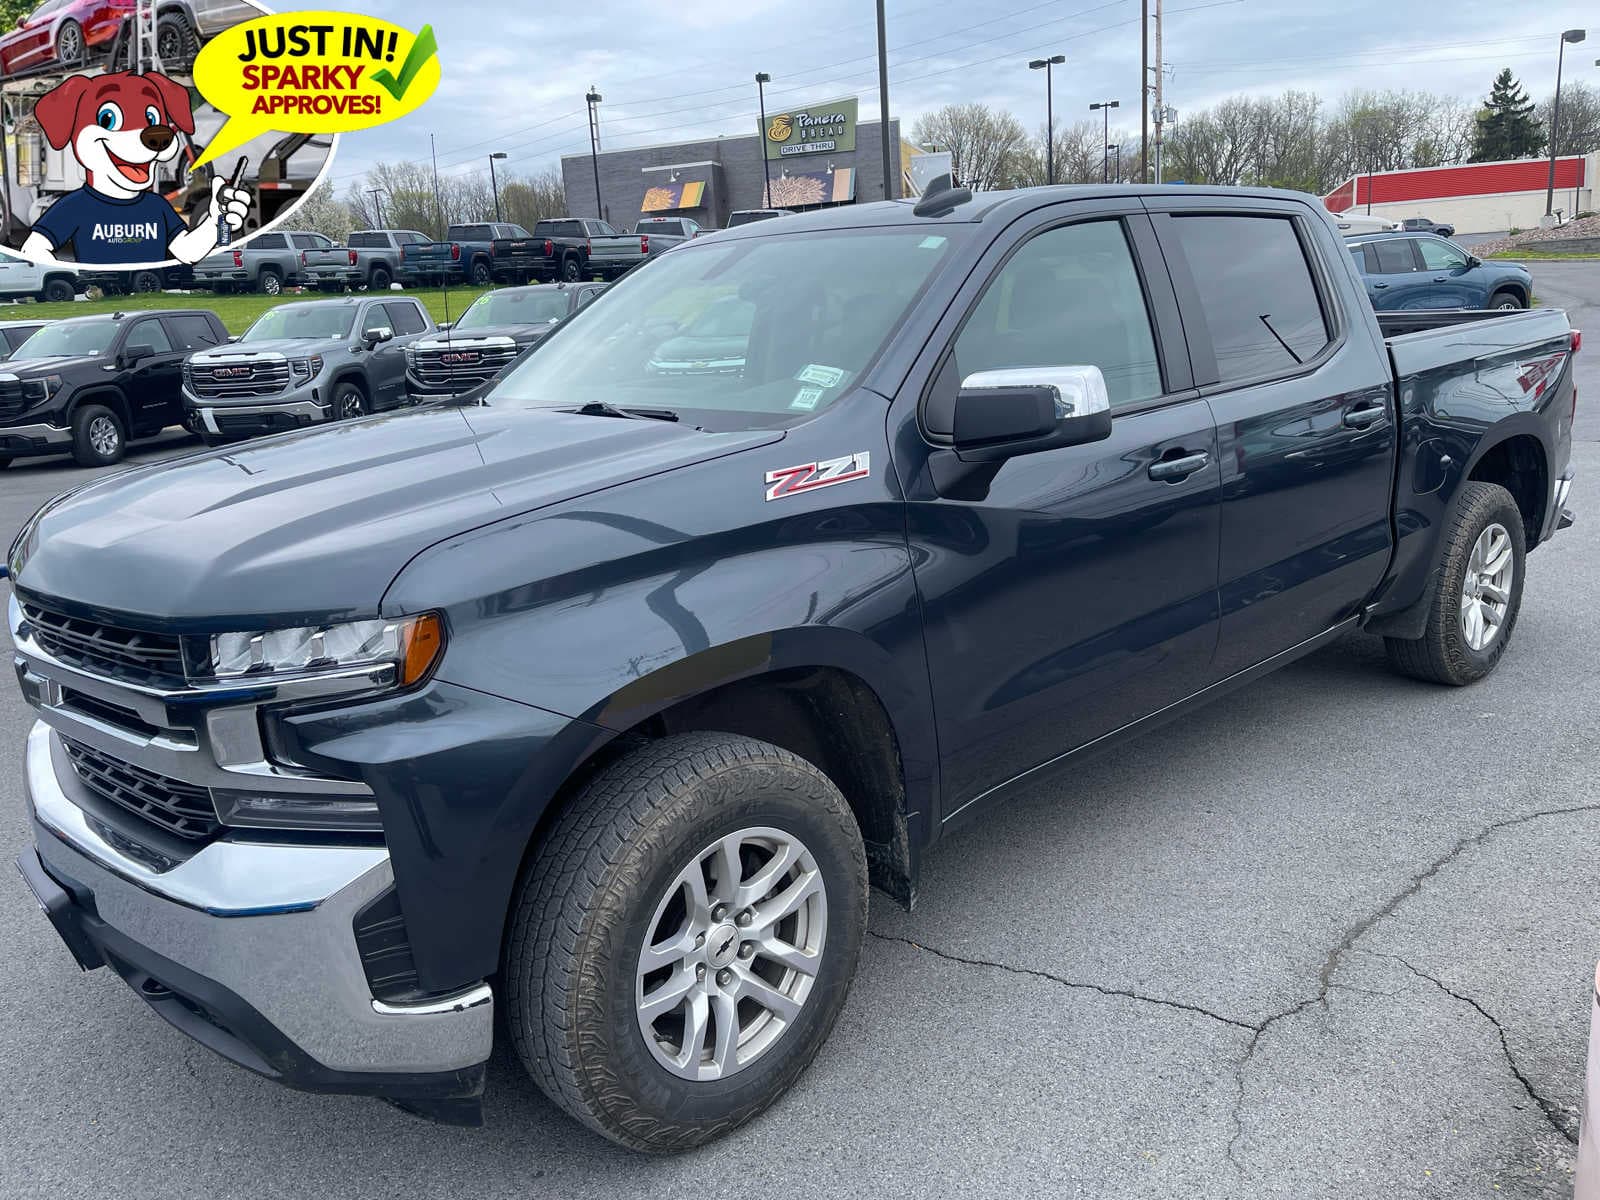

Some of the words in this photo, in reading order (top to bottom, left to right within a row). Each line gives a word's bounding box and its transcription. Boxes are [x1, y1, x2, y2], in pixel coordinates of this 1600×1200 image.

[796, 113, 845, 127] Panera
[801, 126, 843, 138] BREAD
[213, 367, 250, 377] GMC
